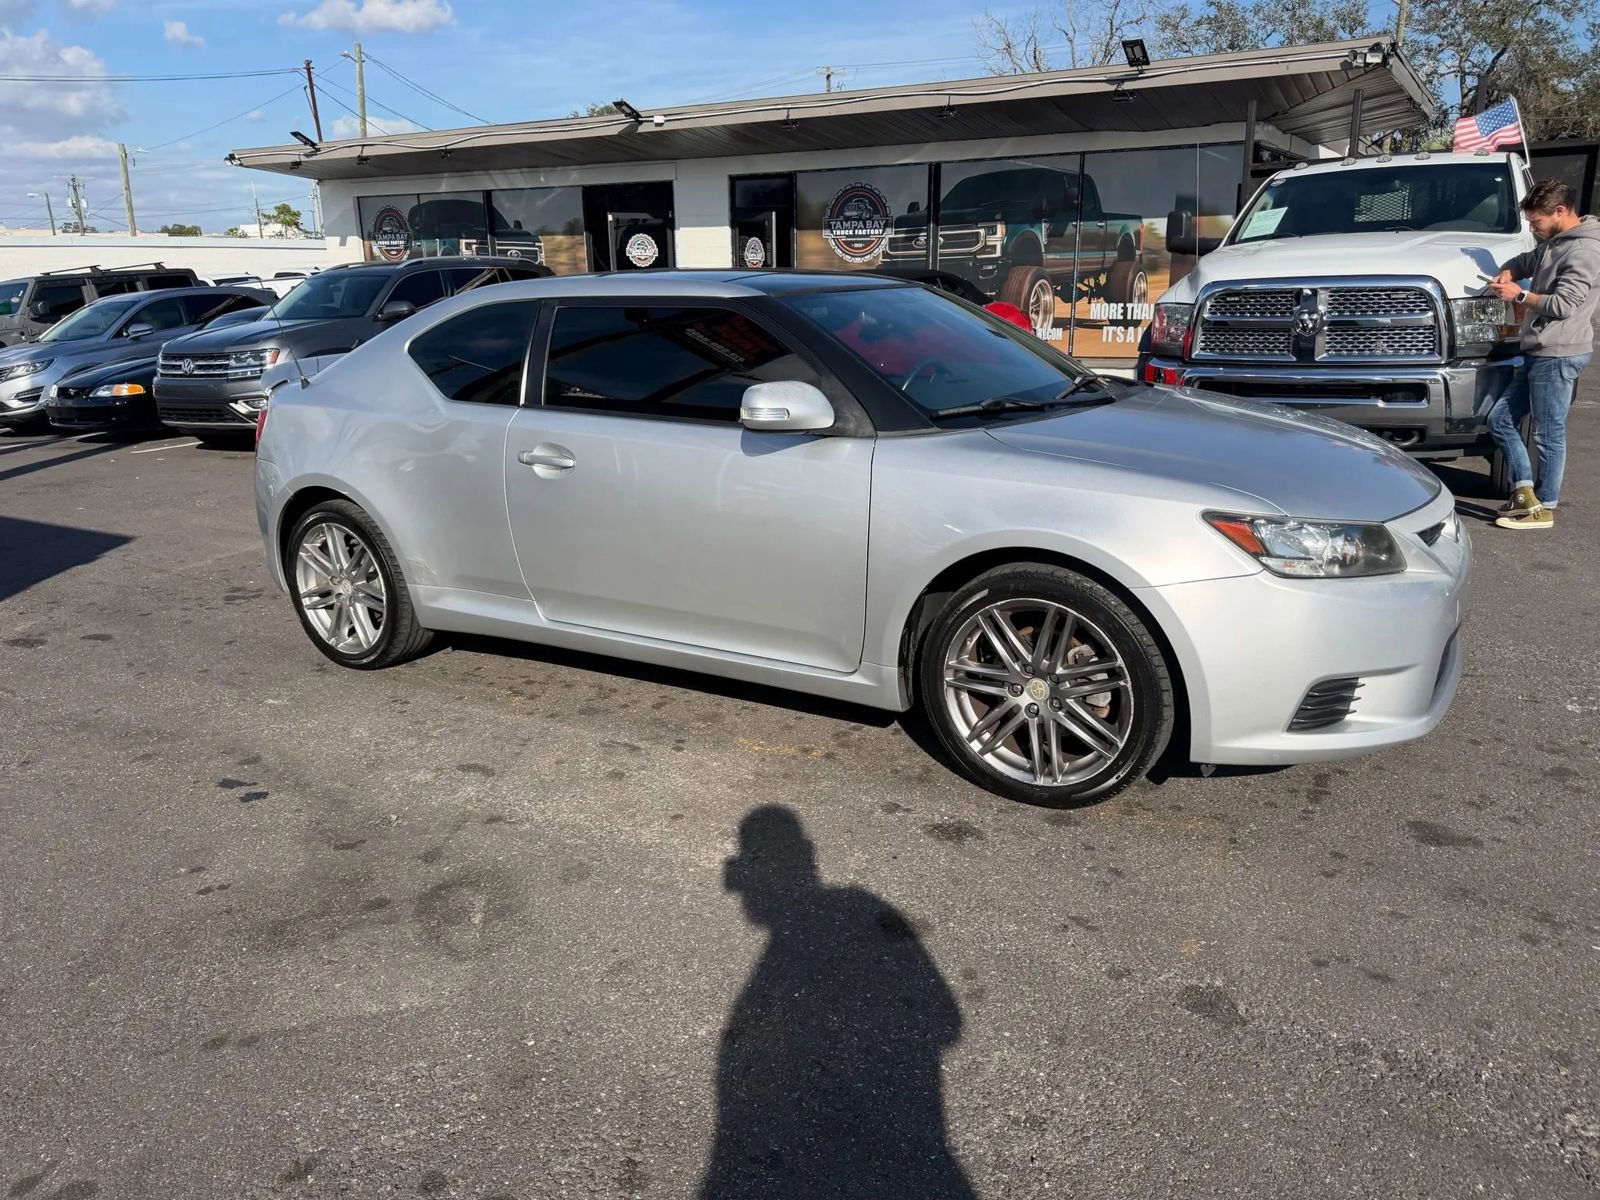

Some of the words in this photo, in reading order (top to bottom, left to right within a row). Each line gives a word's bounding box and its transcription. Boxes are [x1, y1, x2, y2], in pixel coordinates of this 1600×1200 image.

[830, 221, 864, 229] TAMPA
[866, 220, 886, 228] BAY
[375, 233, 396, 241] TAMPA
[1091, 303, 1124, 320] MORE
[1102, 326, 1125, 343] IT'S
[1126, 326, 1135, 343] A
